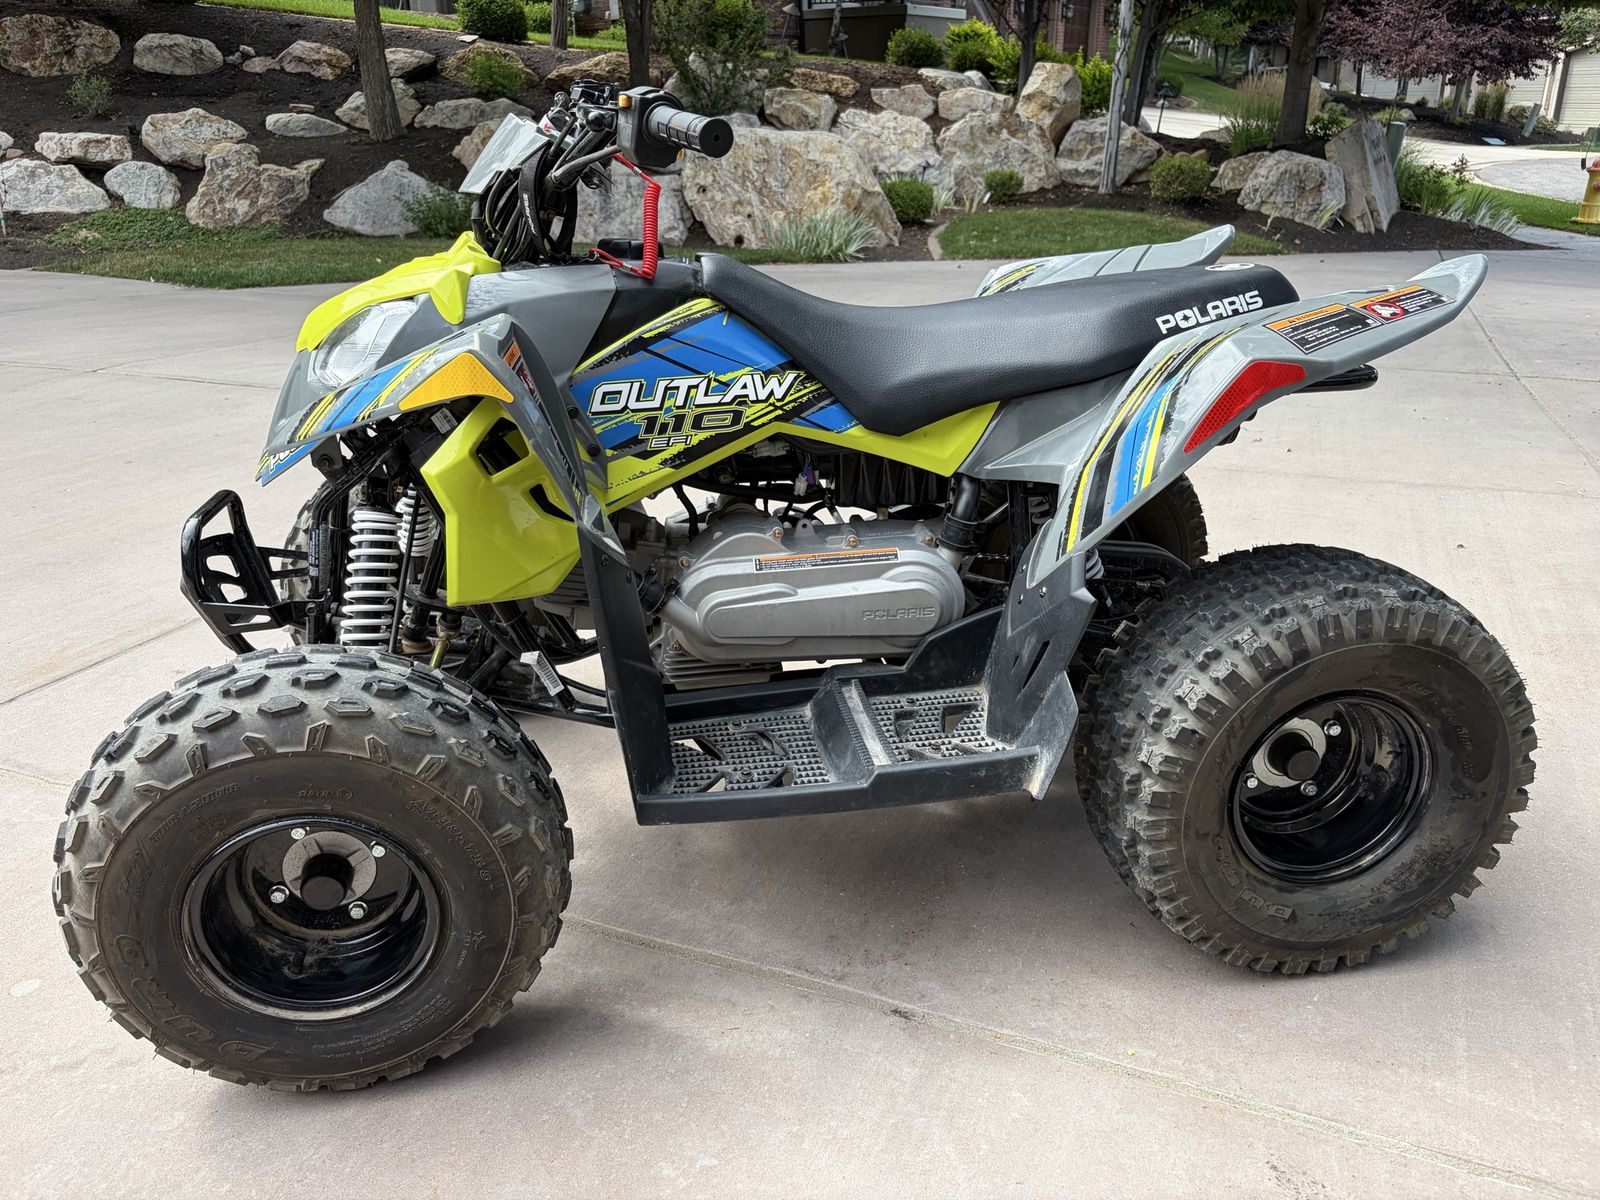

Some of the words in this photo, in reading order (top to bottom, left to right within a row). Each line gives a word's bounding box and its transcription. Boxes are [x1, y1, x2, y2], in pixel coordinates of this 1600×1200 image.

[1155, 290, 1264, 335] POLARIS
[590, 372, 799, 413] OUTLAW
[636, 408, 746, 438] 110
[650, 435, 693, 449] EFI
[861, 606, 936, 621] POLARIS
